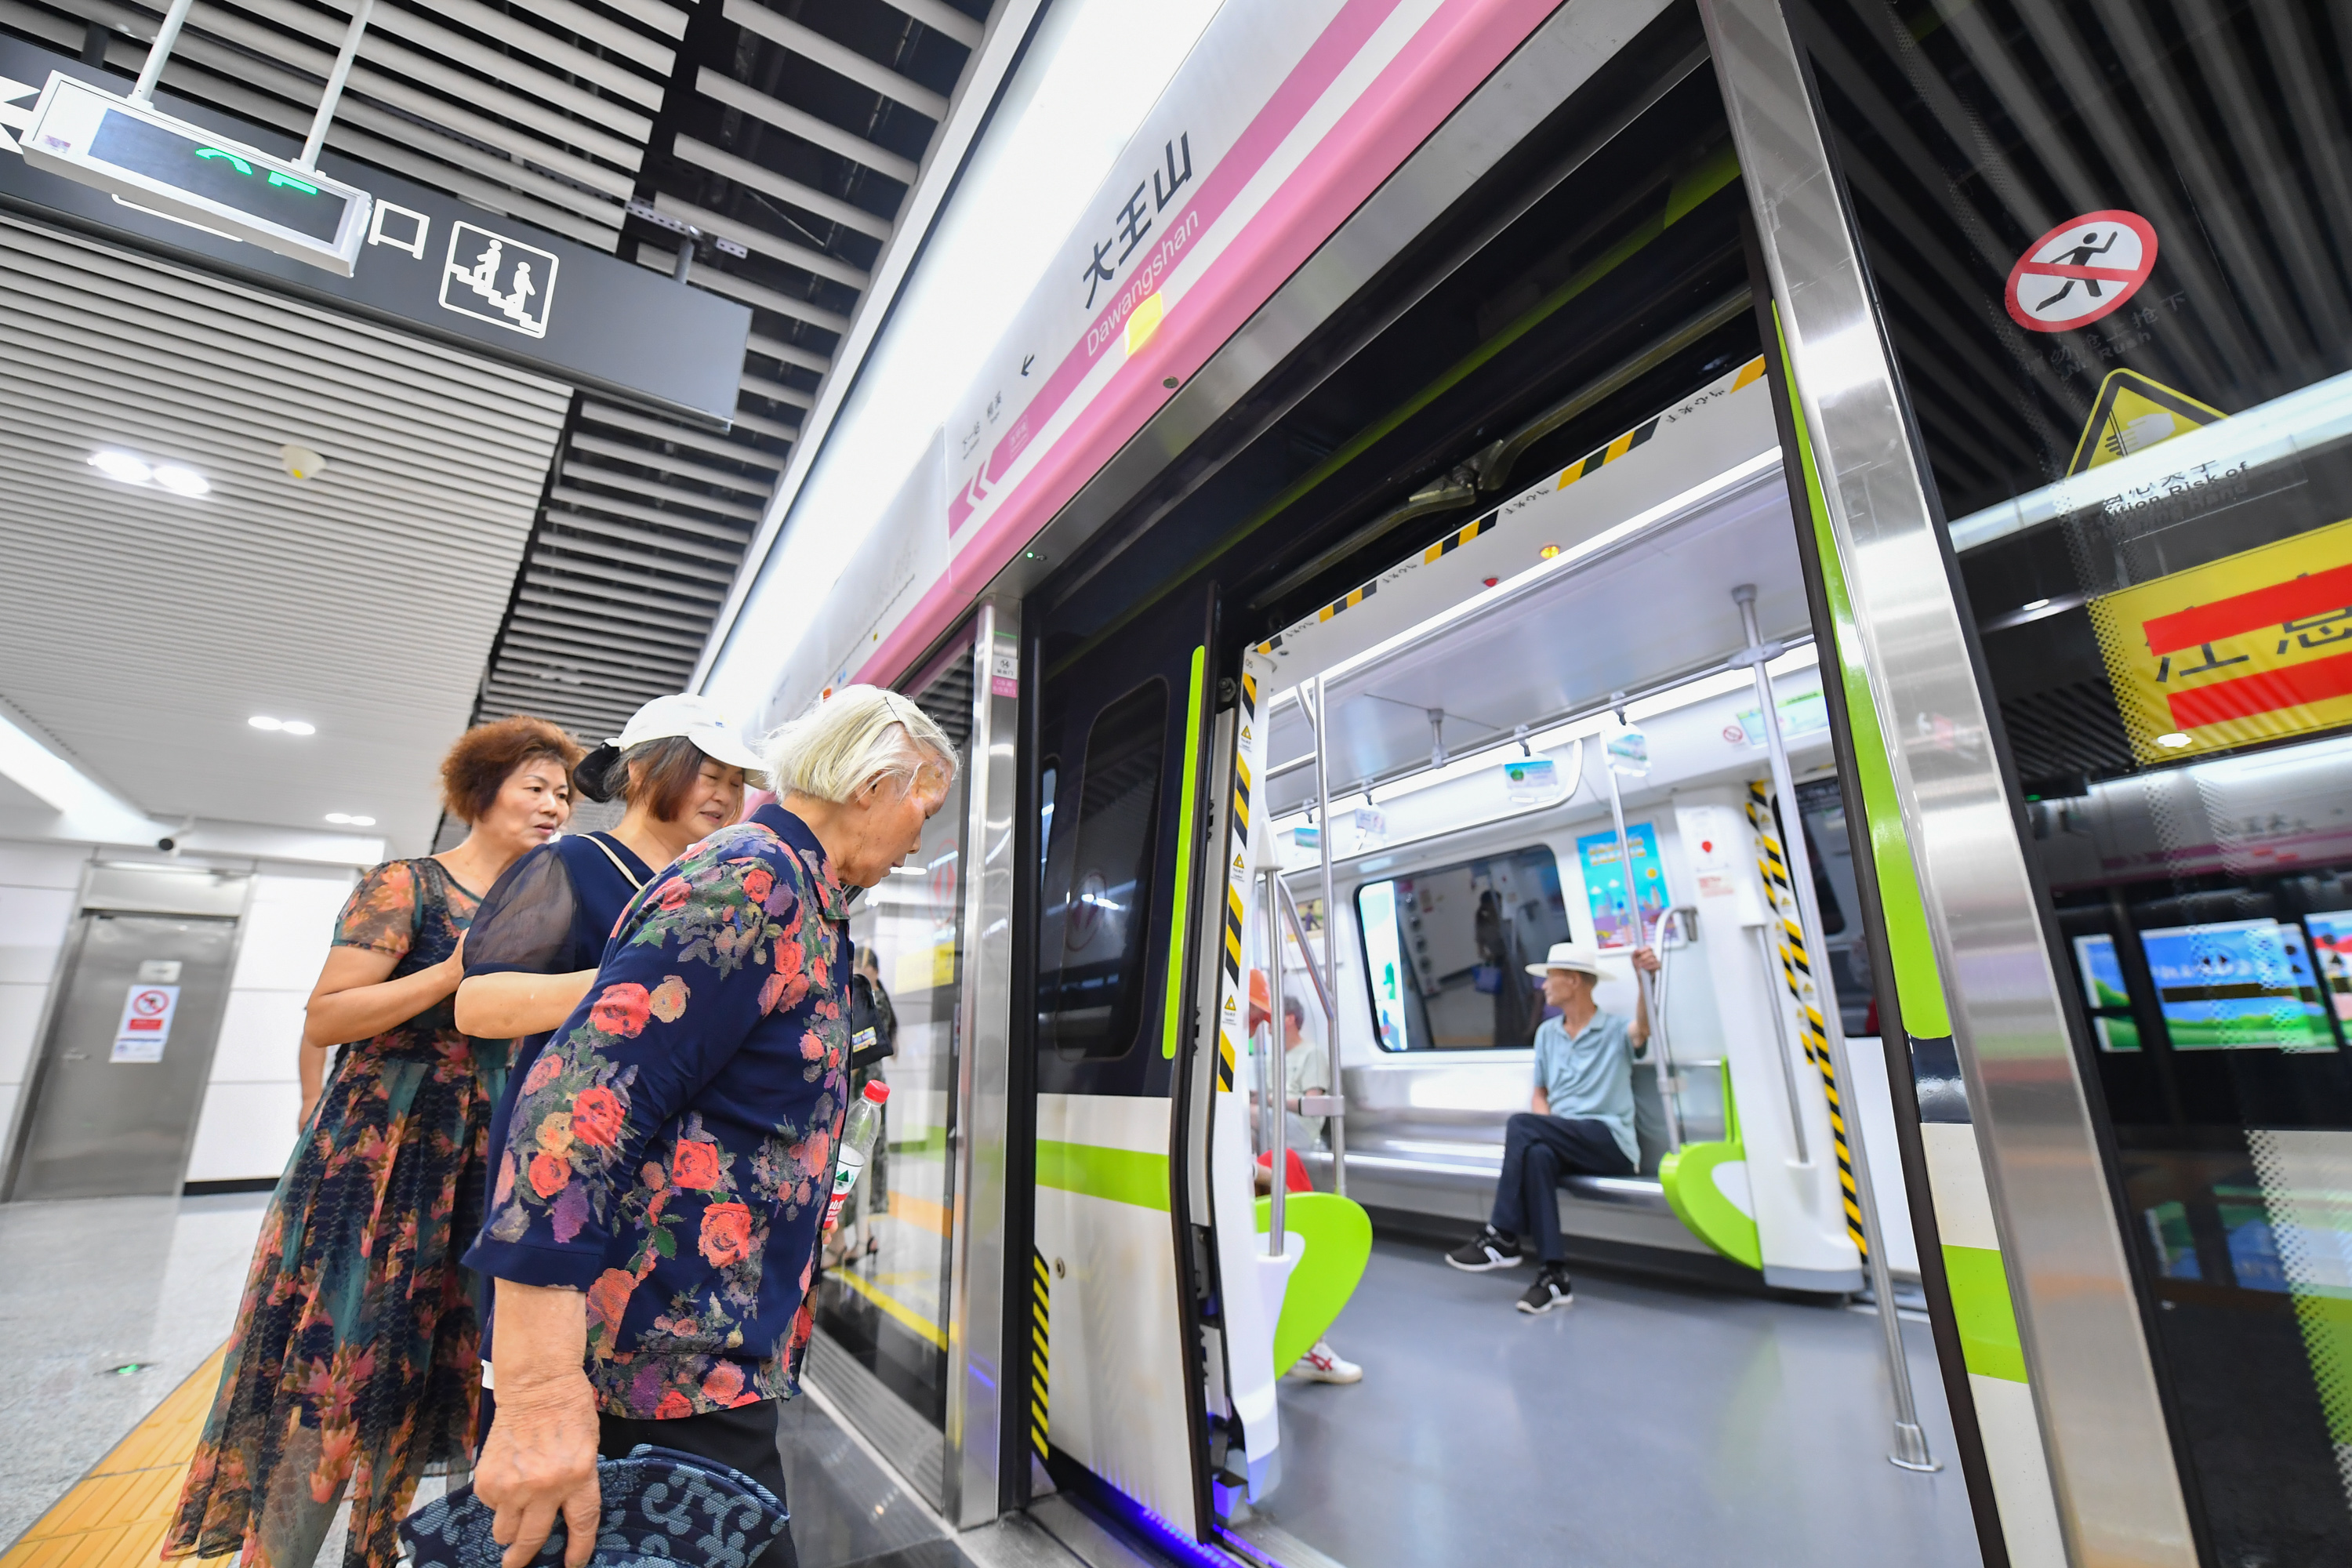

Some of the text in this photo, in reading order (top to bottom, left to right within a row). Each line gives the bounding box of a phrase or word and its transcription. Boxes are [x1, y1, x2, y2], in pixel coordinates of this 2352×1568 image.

[1083, 130, 1192, 309] 大王山
[1087, 210, 1199, 357] Dawangshan
[2100, 331, 2151, 362] Rush
[2168, 474, 2217, 496] Risk
[2225, 460, 2247, 478] of
